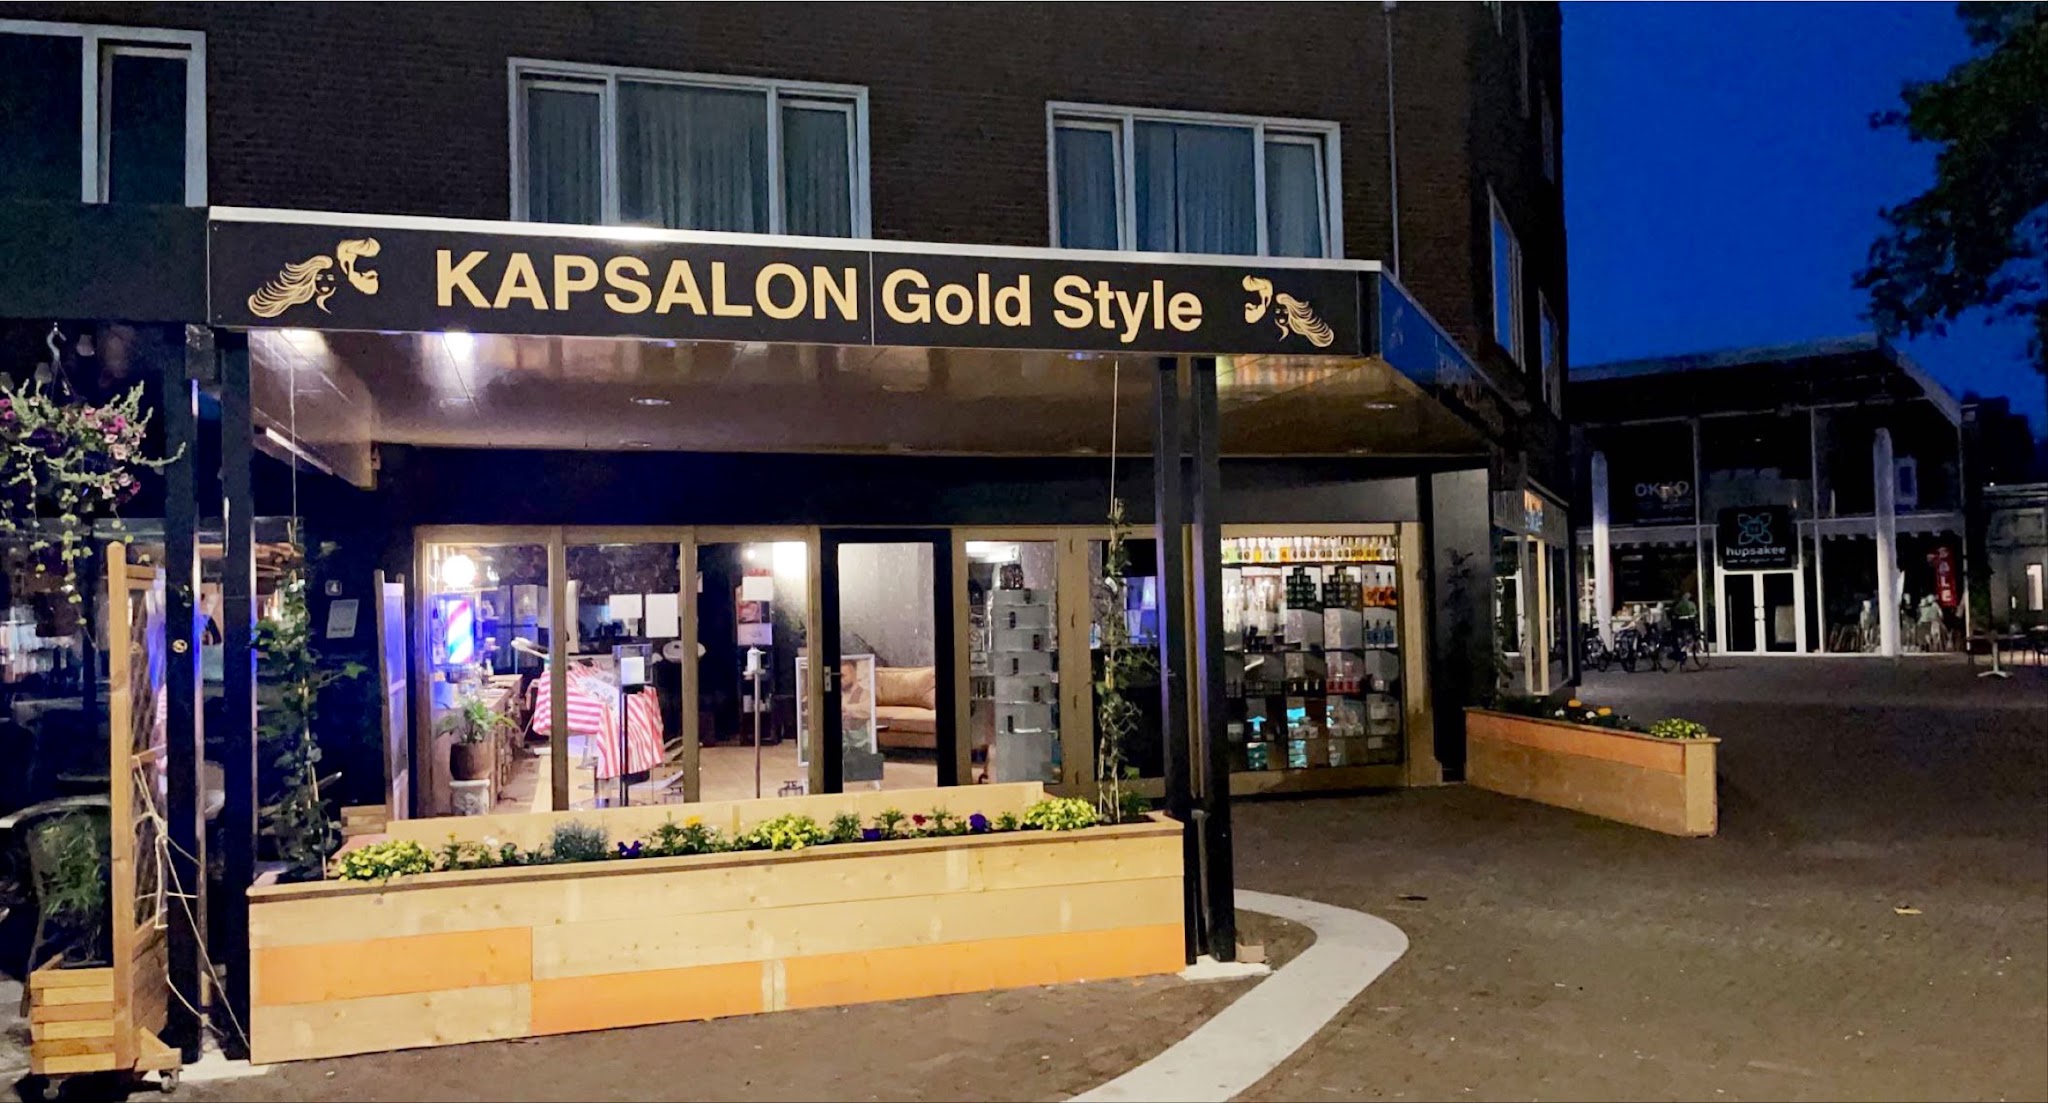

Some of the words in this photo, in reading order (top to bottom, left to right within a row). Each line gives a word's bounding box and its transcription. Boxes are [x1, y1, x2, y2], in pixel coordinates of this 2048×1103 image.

[436, 249, 858, 321] KAPSALON
[881, 268, 1031, 328] Gold
[1053, 274, 1203, 343] Style
[1726, 546, 1787, 558] hupsakee
[1937, 546, 1953, 602] SALE
